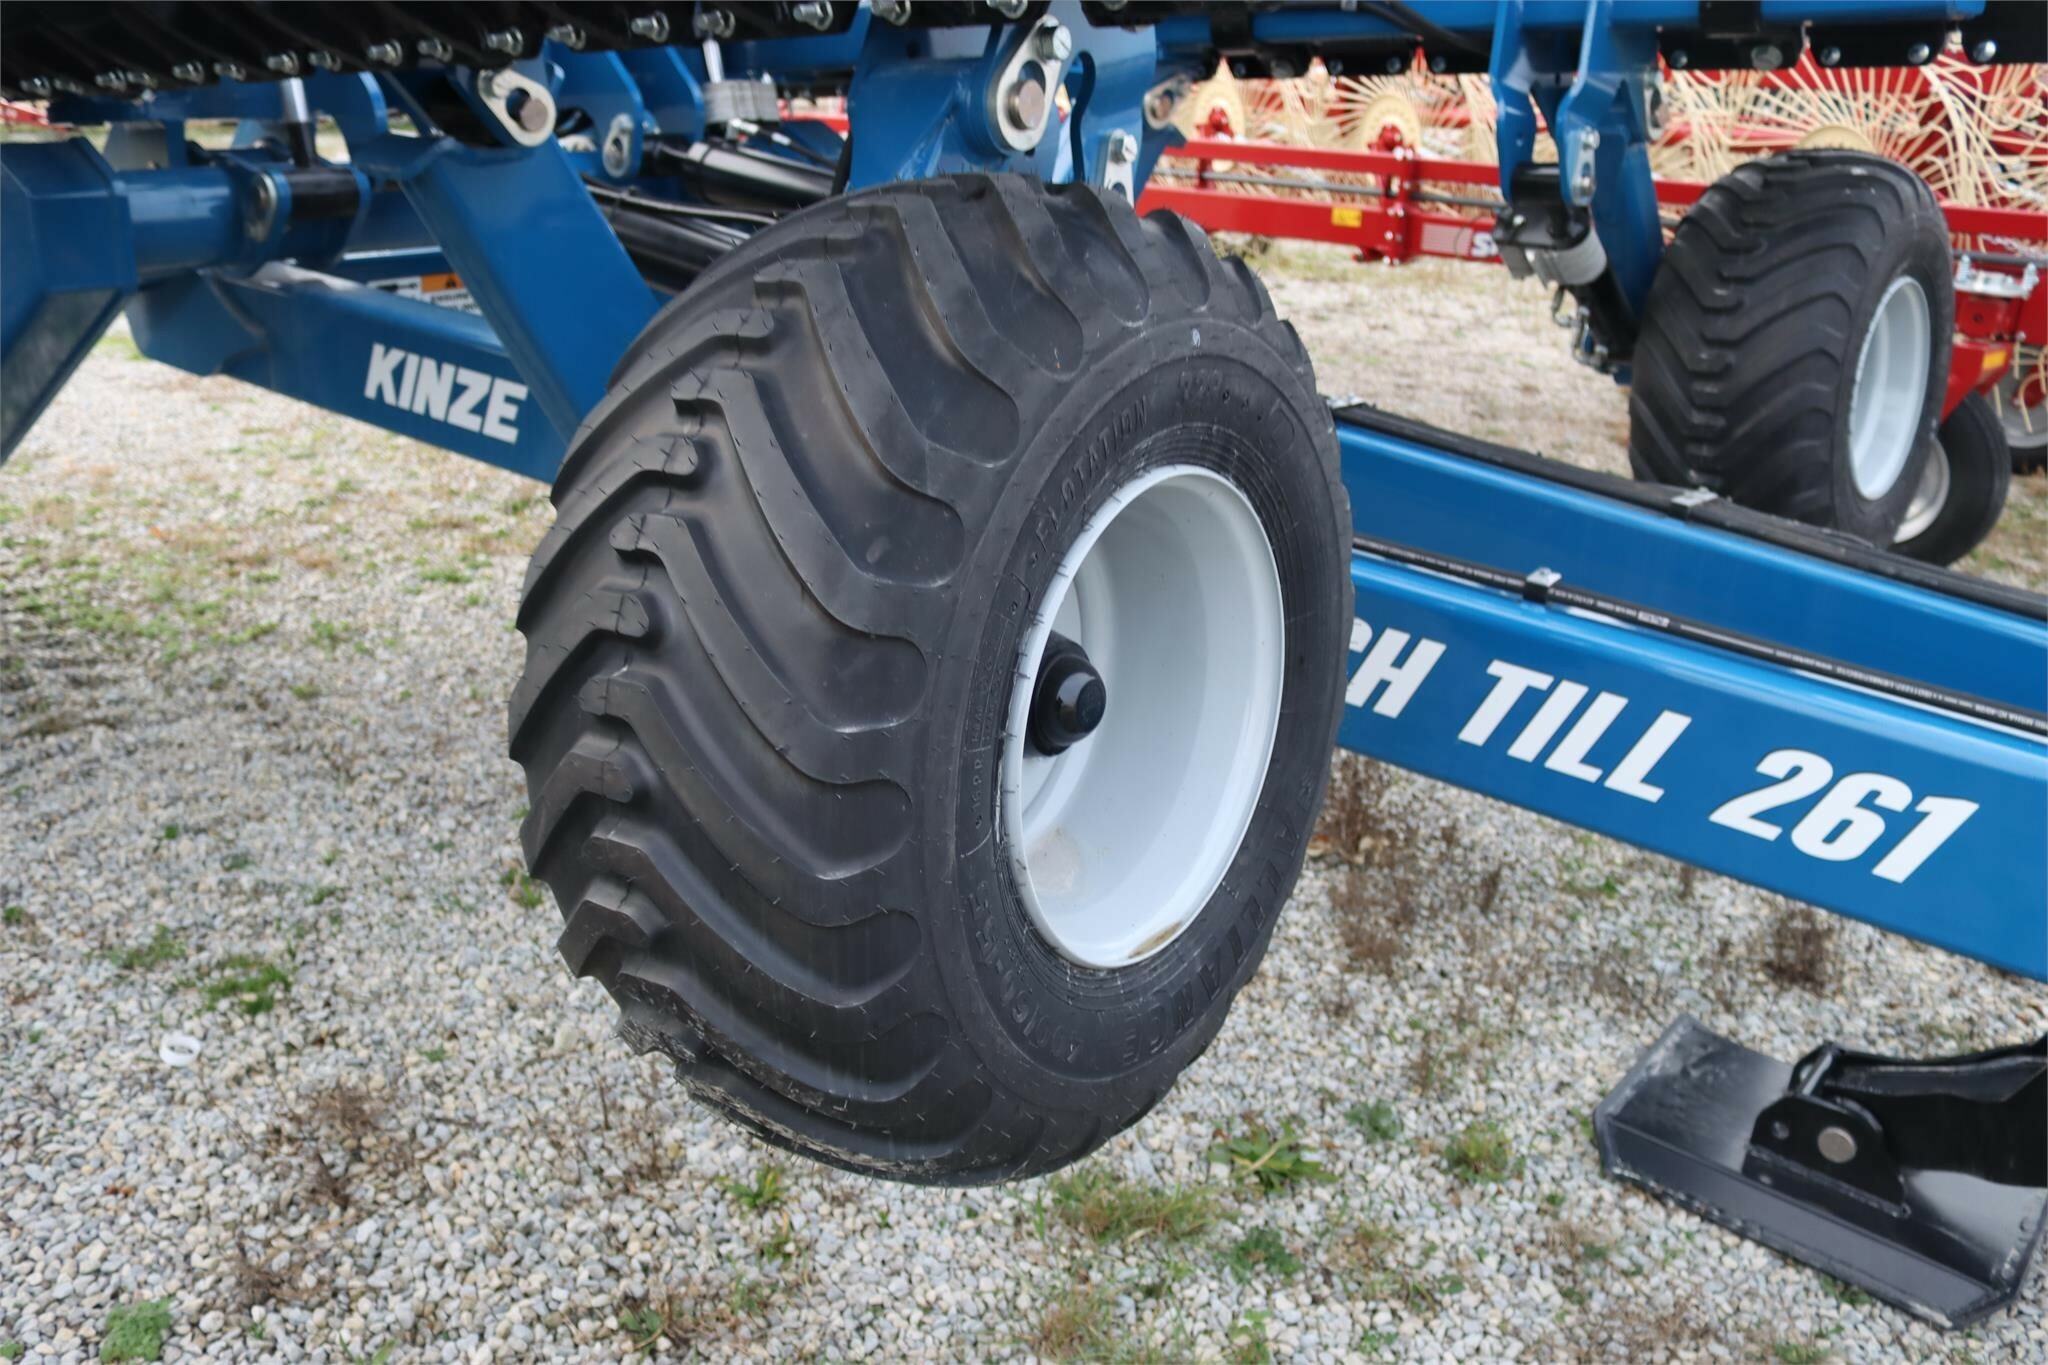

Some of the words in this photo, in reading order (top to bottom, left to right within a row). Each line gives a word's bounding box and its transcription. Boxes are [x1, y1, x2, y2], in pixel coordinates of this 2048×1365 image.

[364, 342, 528, 445] KINZE
[1457, 660, 1692, 803] TILL
[1708, 748, 1980, 884] 261
[1121, 808, 1302, 1066] ALLIANCE
